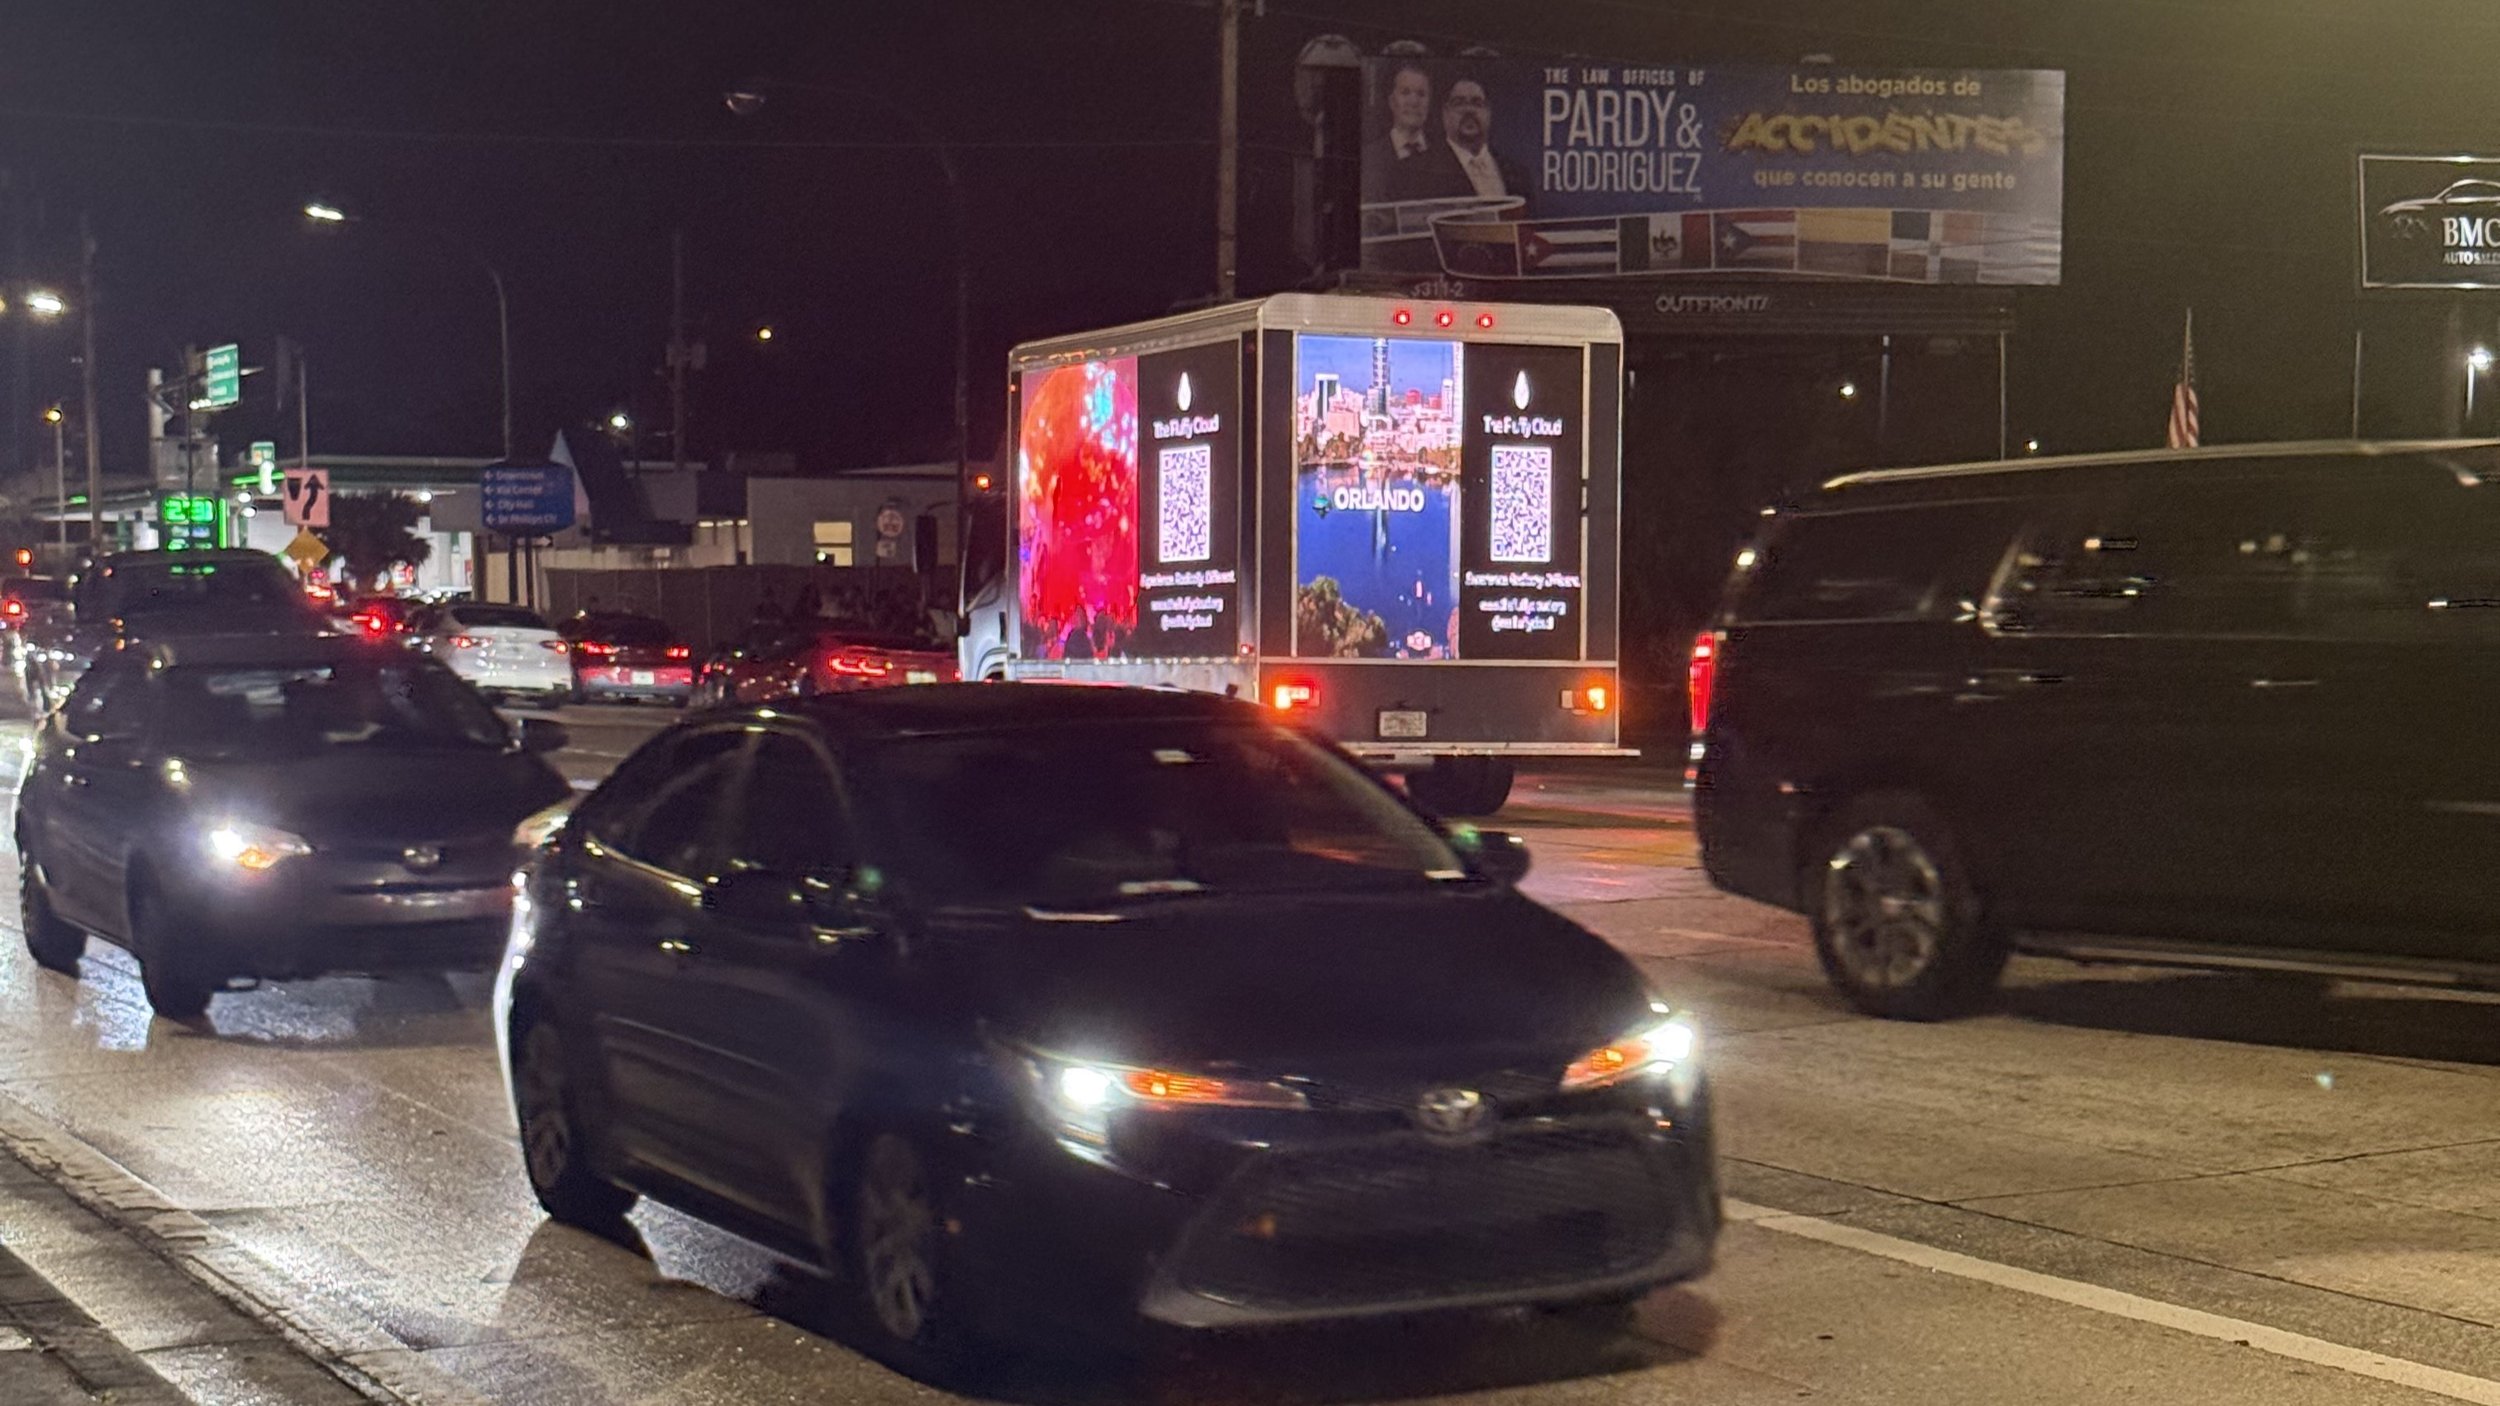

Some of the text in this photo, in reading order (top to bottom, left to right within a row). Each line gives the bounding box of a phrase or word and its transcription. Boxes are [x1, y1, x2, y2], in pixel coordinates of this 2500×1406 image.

[1544, 69, 1705, 86] THE LAW OFFICES OF
[1790, 75, 1981, 97] Los abogados de
[1543, 89, 1703, 149] PARDY &
[1727, 110, 2046, 154] ACCIDENTES
[1543, 151, 1702, 193] RODRIGUEZ
[1754, 169, 2016, 192] que conocen a su gente
[2441, 216, 2500, 248] BMC
[1334, 486, 1425, 512] ORLANDO
